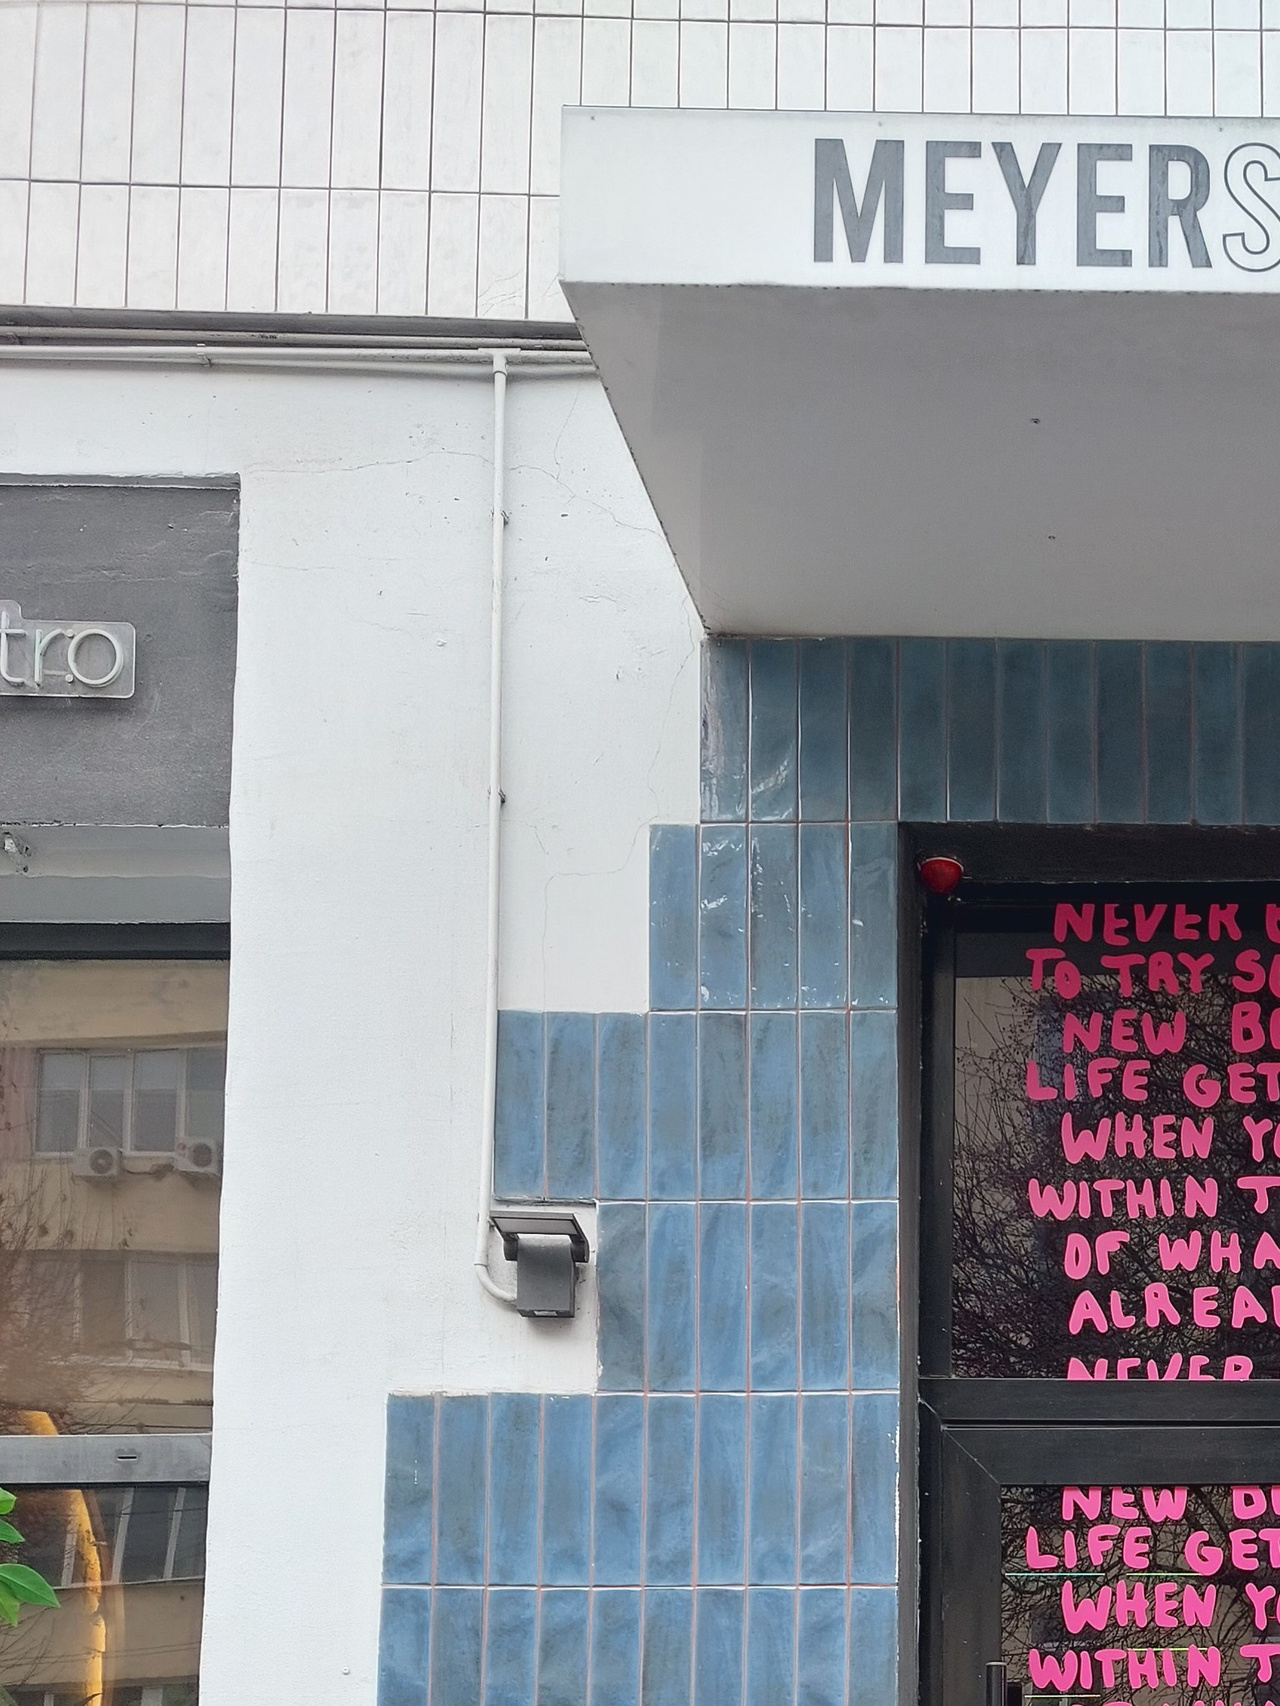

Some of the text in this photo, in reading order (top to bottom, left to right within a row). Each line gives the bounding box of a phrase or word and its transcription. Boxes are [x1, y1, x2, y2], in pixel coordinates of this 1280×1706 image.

[1055, 904, 1241, 945] NEVER
[1027, 949, 1081, 999] TO
[1101, 952, 1213, 997] TRY
[1063, 1010, 1186, 1055] NEW
[1026, 1057, 1150, 1101] LIFE
[1061, 1112, 1213, 1164] WHEN
[1028, 1176, 1218, 1220] WITHIN
[1064, 1231, 1129, 1279] OF
[1062, 1487, 1187, 1523] NEW
[1026, 1525, 1151, 1570] LIFE
[1061, 1581, 1216, 1634] WHEN
[1028, 1645, 1221, 1692] WITHIN
